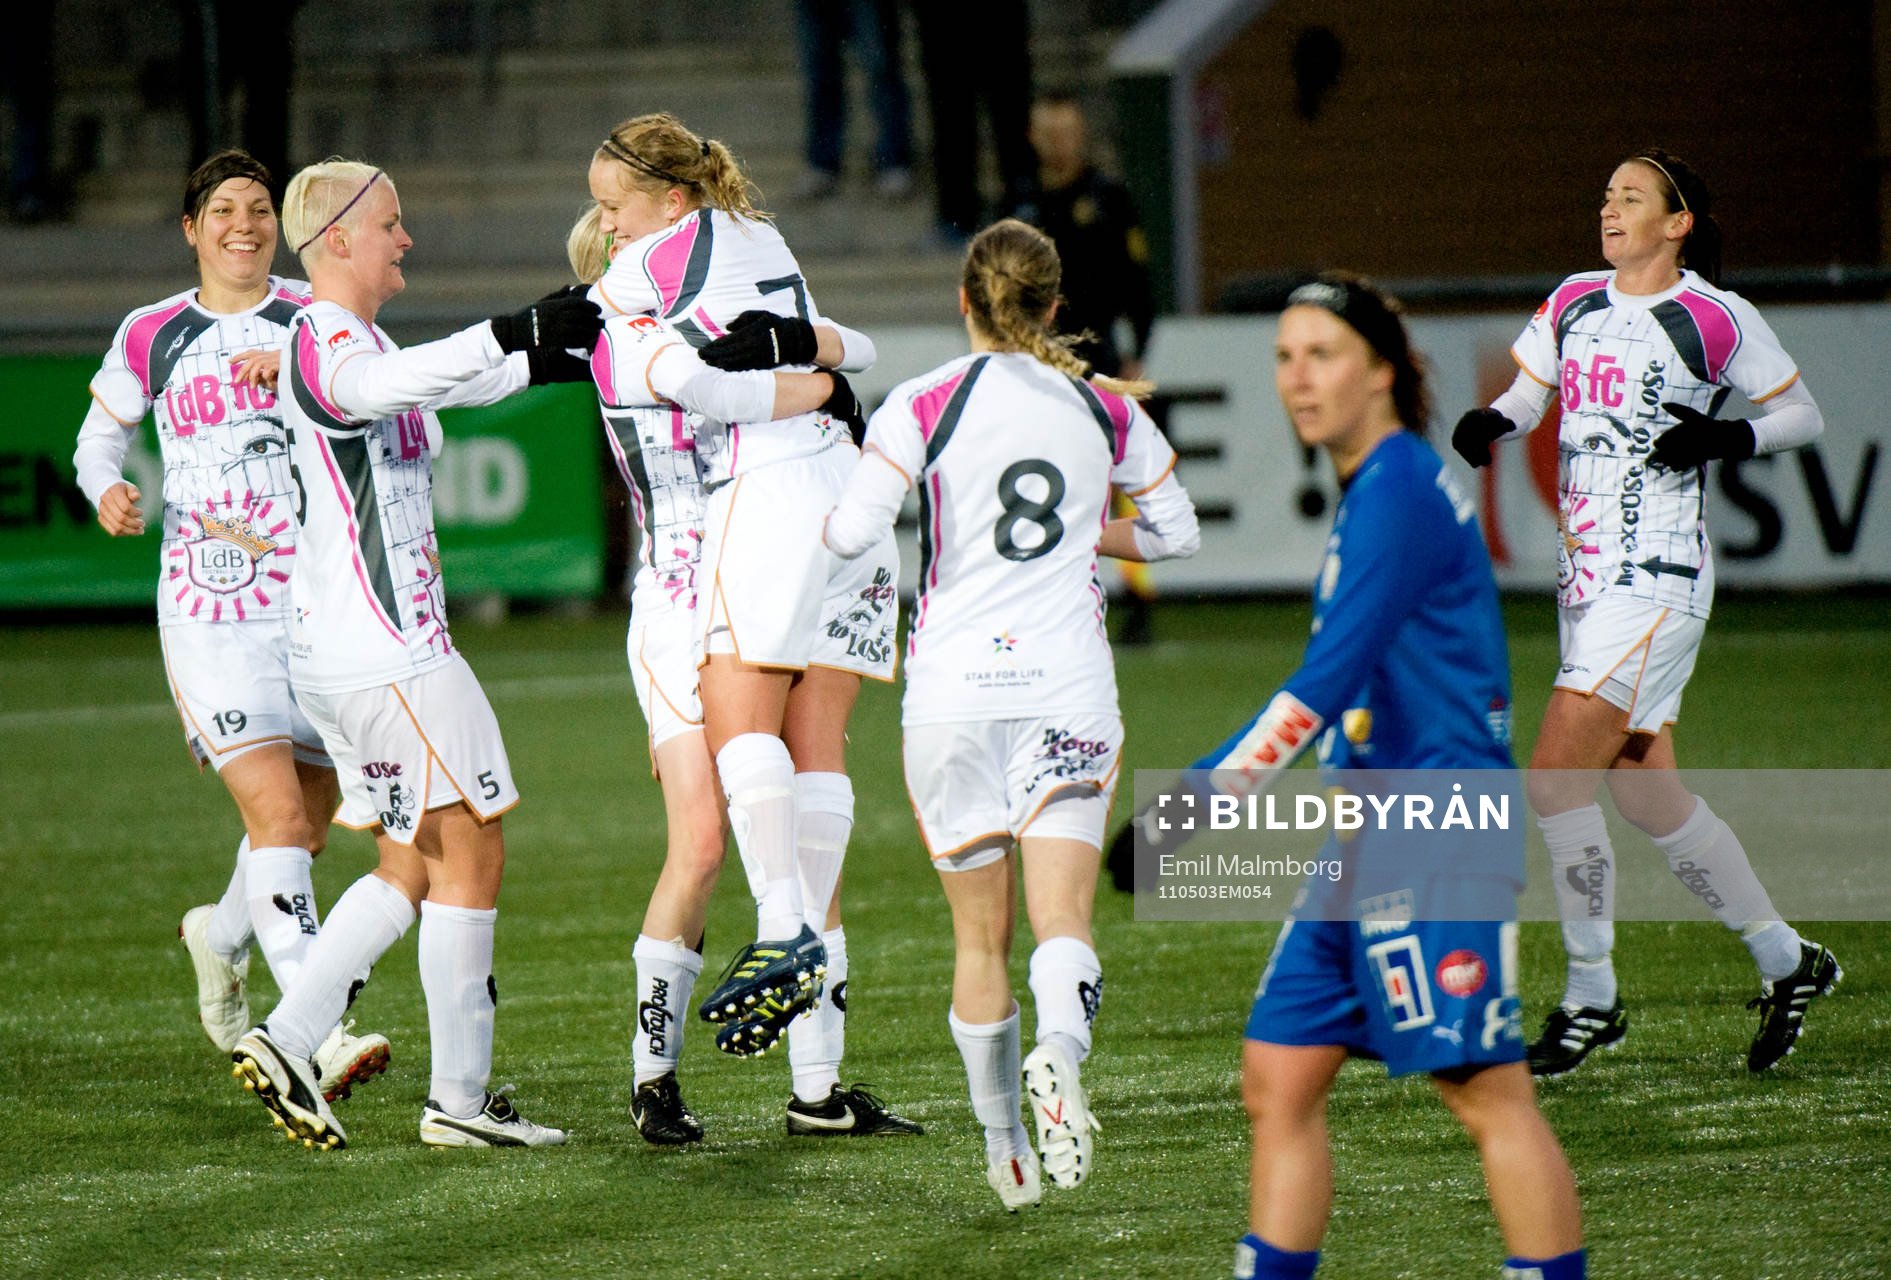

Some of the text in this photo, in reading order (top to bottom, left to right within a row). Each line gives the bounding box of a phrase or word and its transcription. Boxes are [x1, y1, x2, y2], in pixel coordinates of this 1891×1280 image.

[165, 374, 226, 437] LdB
[995, 458, 1065, 562] 8
[201, 547, 245, 569] LdB
[965, 668, 1045, 681] STAR FOR LIFE
[212, 709, 248, 736] 19
[477, 769, 501, 801] 5
